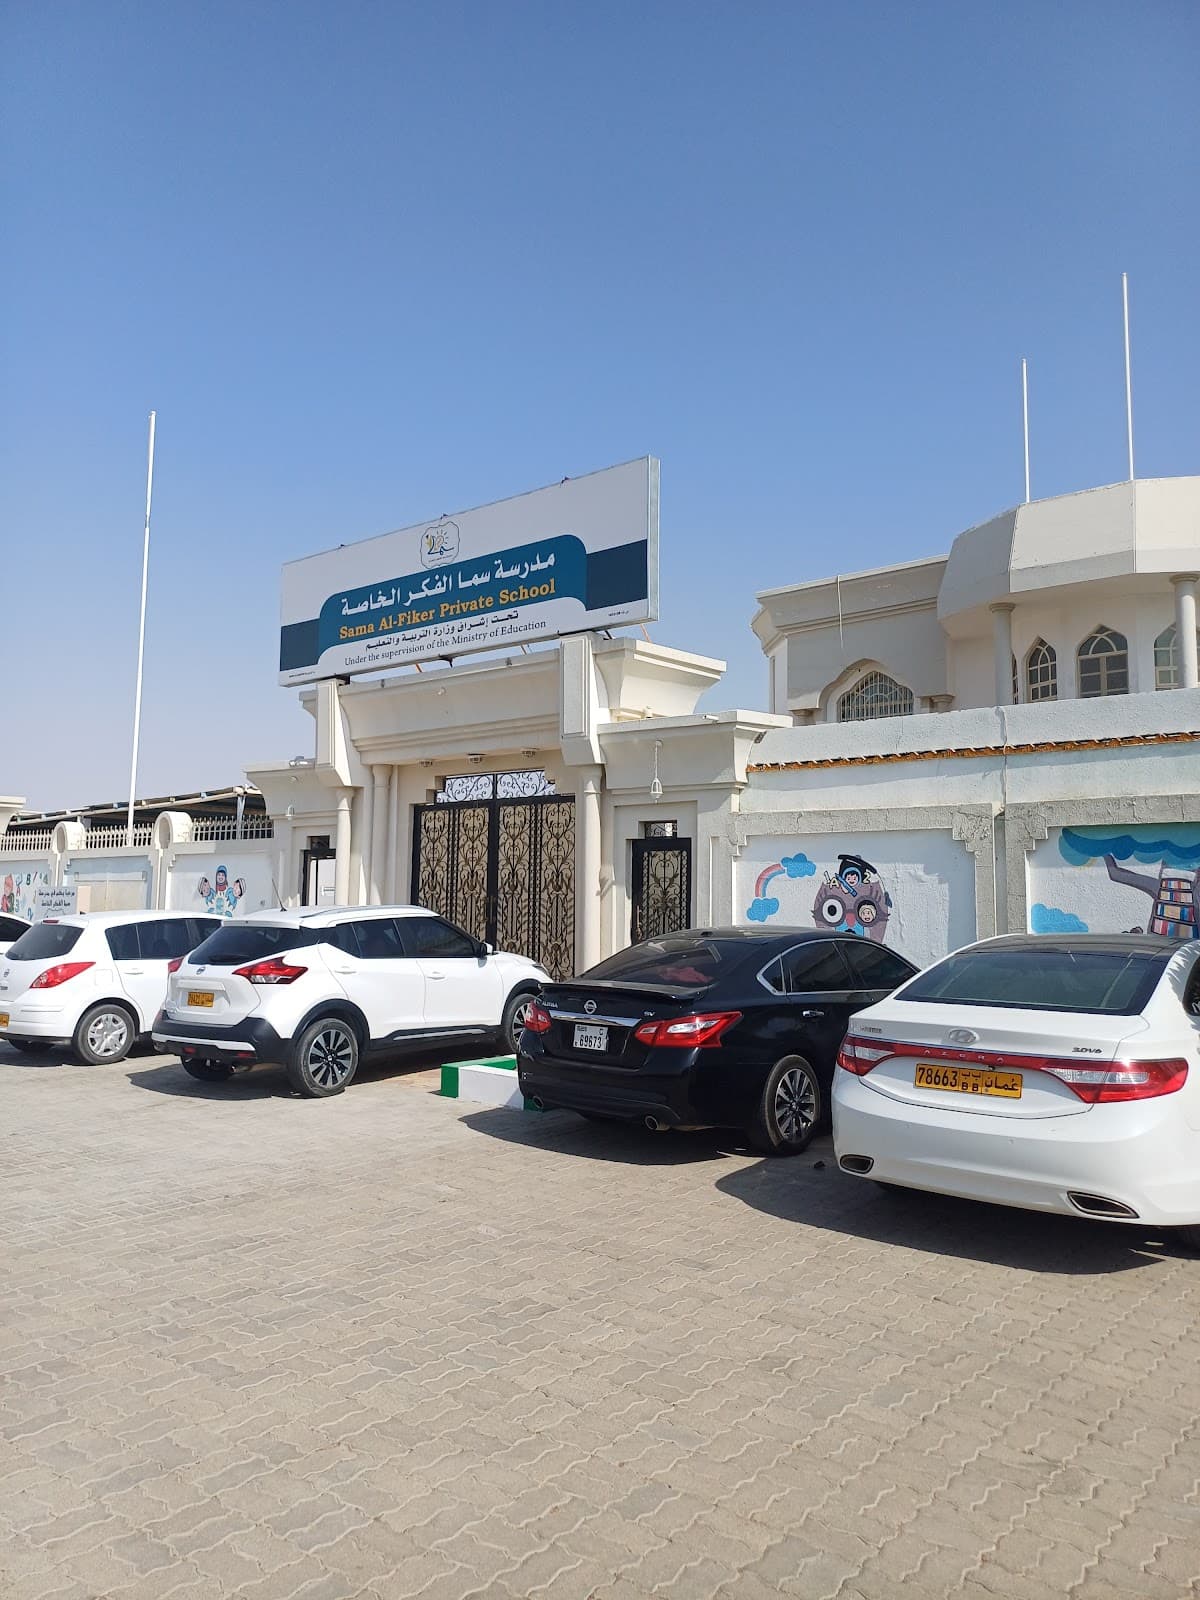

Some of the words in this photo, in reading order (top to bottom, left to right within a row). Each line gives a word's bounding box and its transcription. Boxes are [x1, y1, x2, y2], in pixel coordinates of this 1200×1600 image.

[494, 553, 555, 579] مدرسة
[458, 570, 491, 589] سما
[403, 573, 453, 607] الفكر
[339, 623, 375, 640] Sama
[378, 608, 435, 632] Al-Fiker
[439, 594, 494, 619] Private
[499, 578, 556, 605] School
[341, 587, 401, 616] الخاصة
[491, 609, 519, 624] تحت
[401, 628, 432, 643] التربية
[433, 624, 455, 637] وزارة
[344, 654, 367, 667] Under
[368, 650, 381, 662] the
[381, 643, 425, 661] supervision
[426, 639, 435, 650] of
[436, 637, 450, 648] the
[451, 629, 488, 646] Ministry
[489, 627, 499, 639] of
[501, 619, 547, 636] Education
[365, 636, 400, 653] والتعليم
[579, 1034, 602, 1049] 69673
[918, 1067, 958, 1088] 78663
